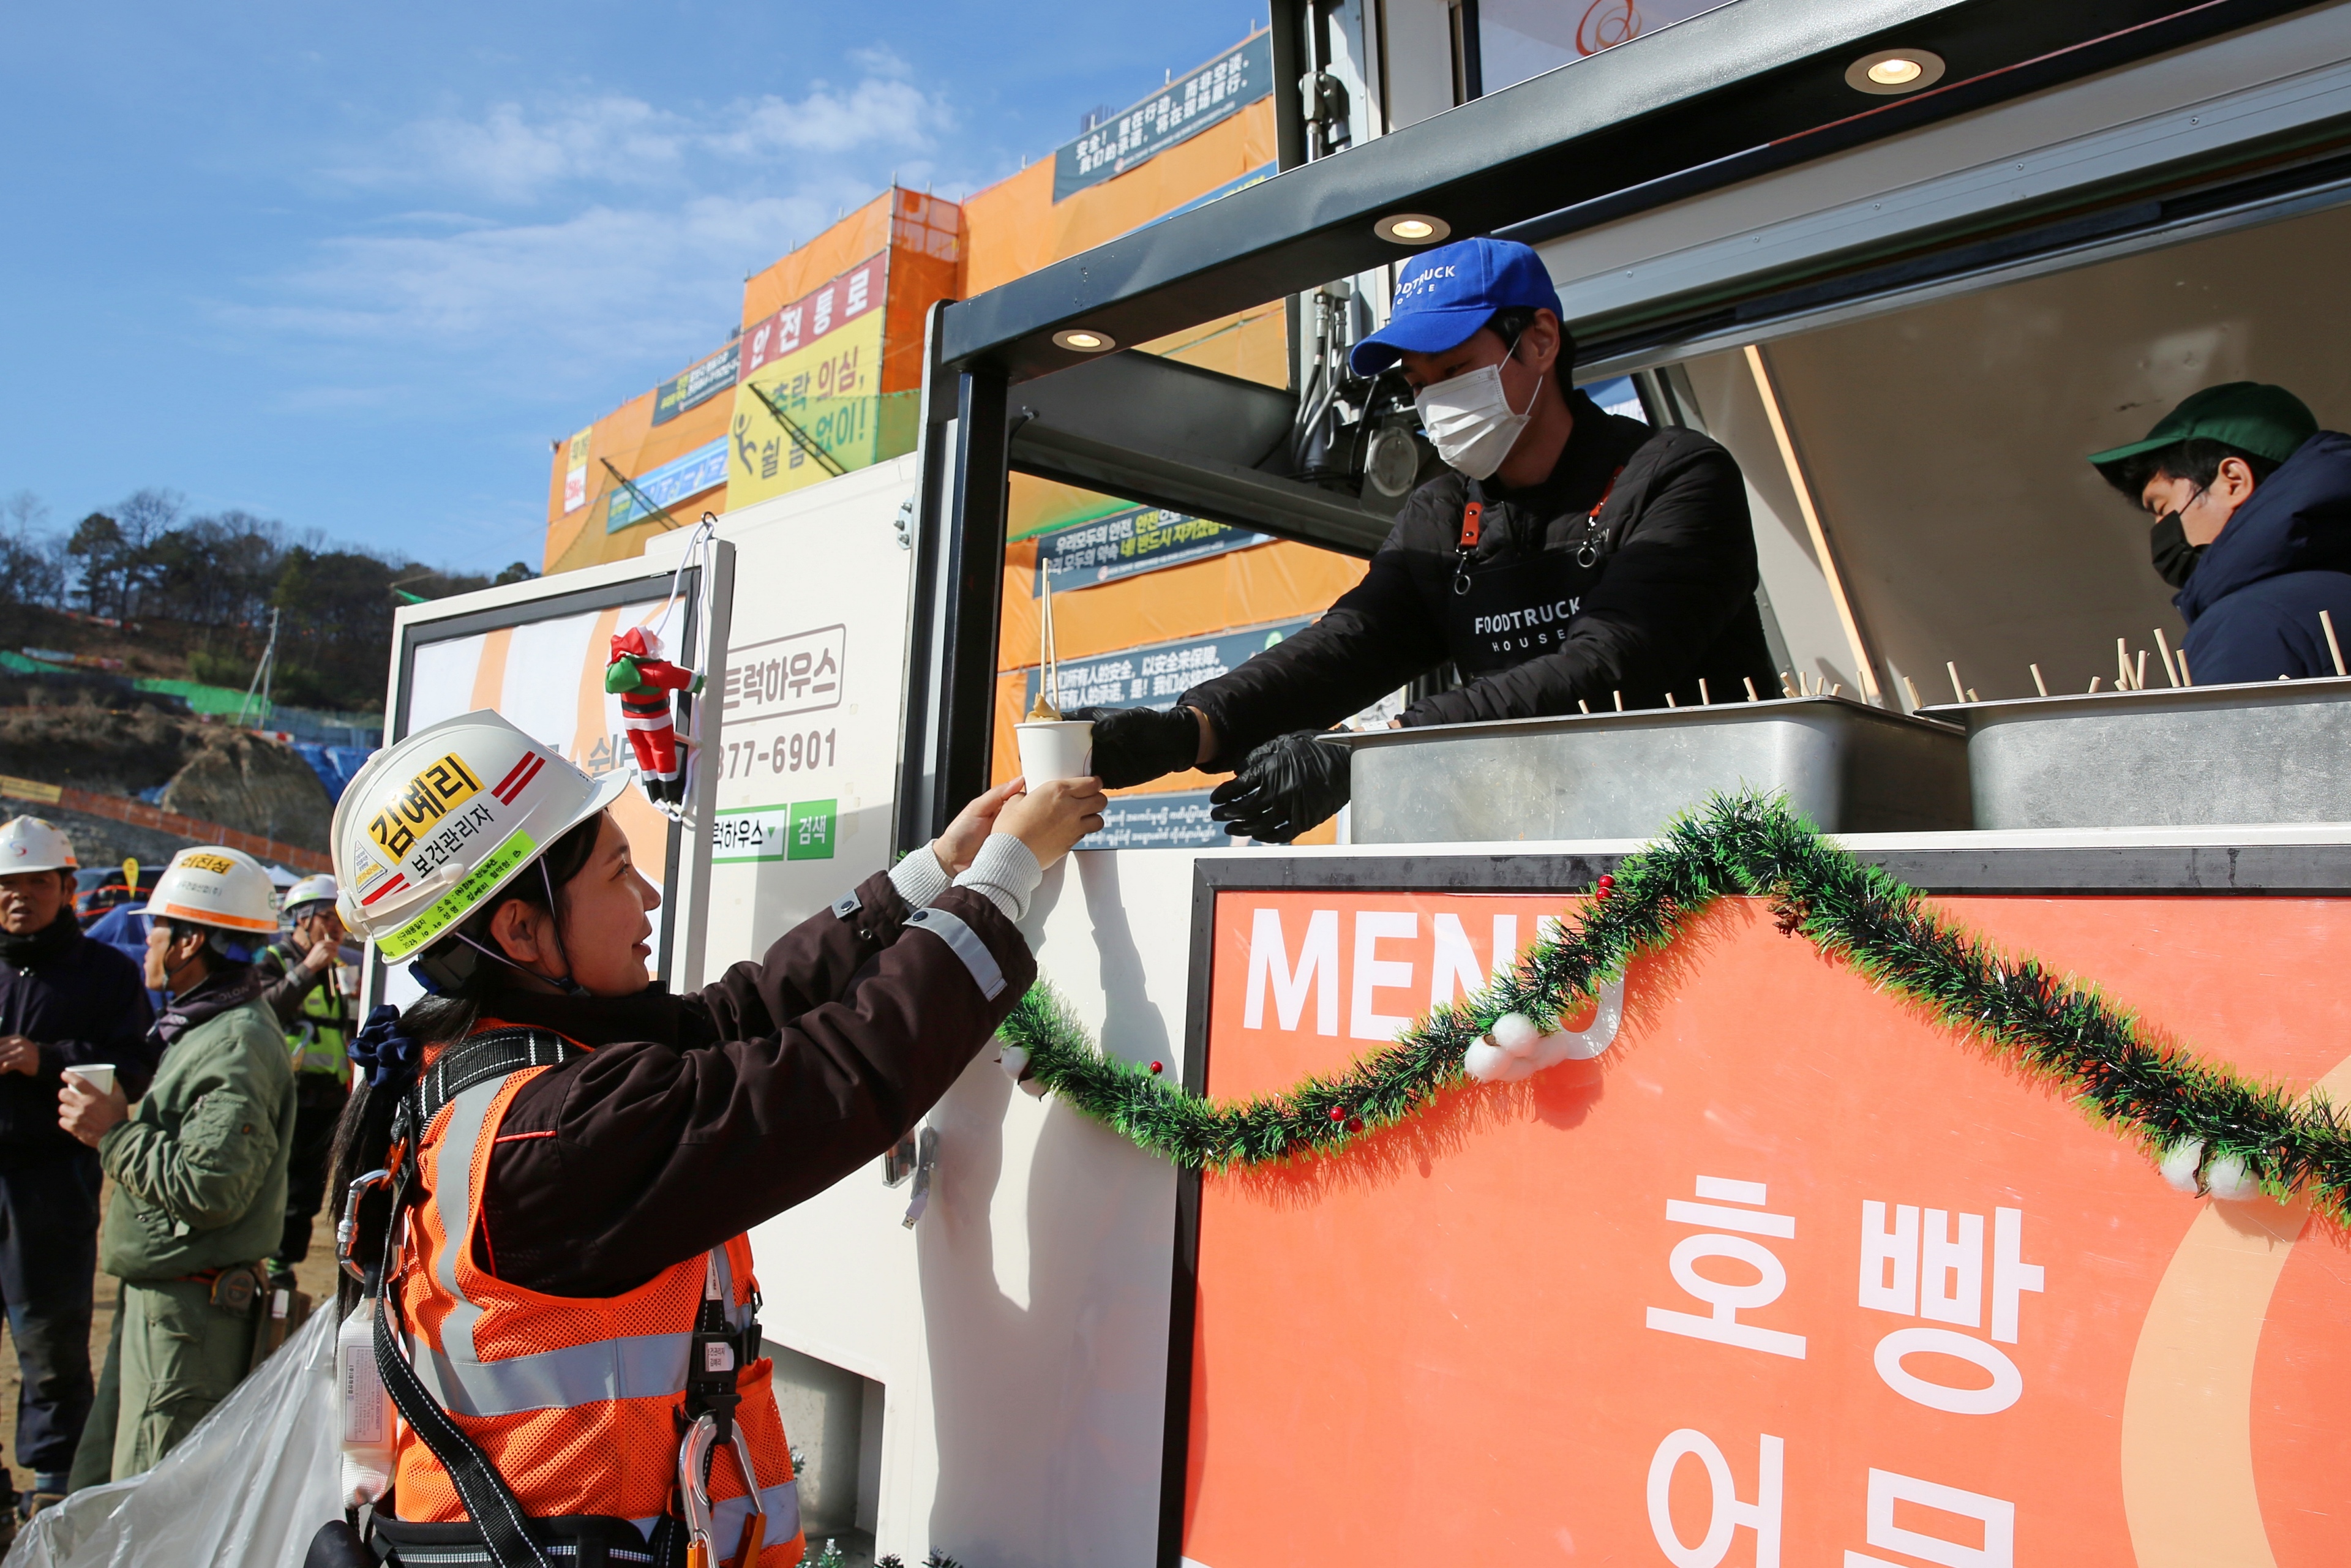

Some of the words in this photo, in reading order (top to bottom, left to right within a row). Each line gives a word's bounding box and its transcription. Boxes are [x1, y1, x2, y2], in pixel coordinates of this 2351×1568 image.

[1392, 283, 1435, 310] OUSE
[1475, 597, 1580, 634] FOODTRUCK
[1492, 629, 1566, 652] HOUSE
[370, 756, 479, 858] 김예리
[411, 803, 495, 879] 보건관리자
[798, 814, 827, 845] 검색
[708, 1347, 726, 1357] 건관리자
